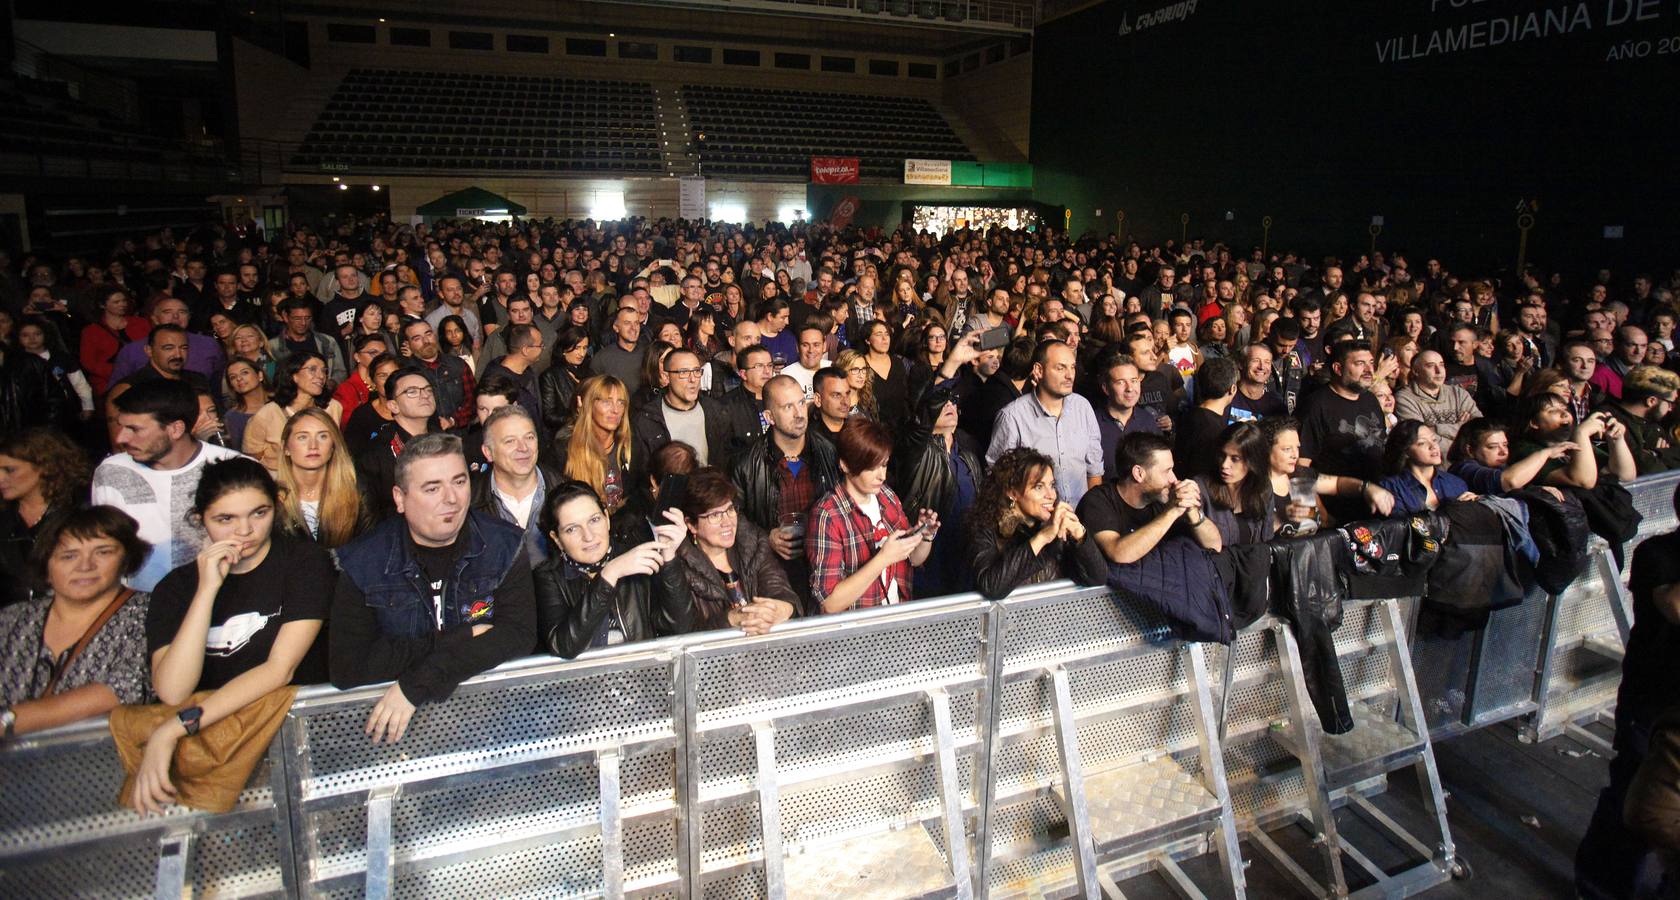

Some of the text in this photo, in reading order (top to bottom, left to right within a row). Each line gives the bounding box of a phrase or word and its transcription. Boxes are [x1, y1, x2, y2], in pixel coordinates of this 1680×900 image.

[1376, 0, 1660, 64] VILLAMEDIANA DE
[1605, 39, 1652, 62] AÑO
